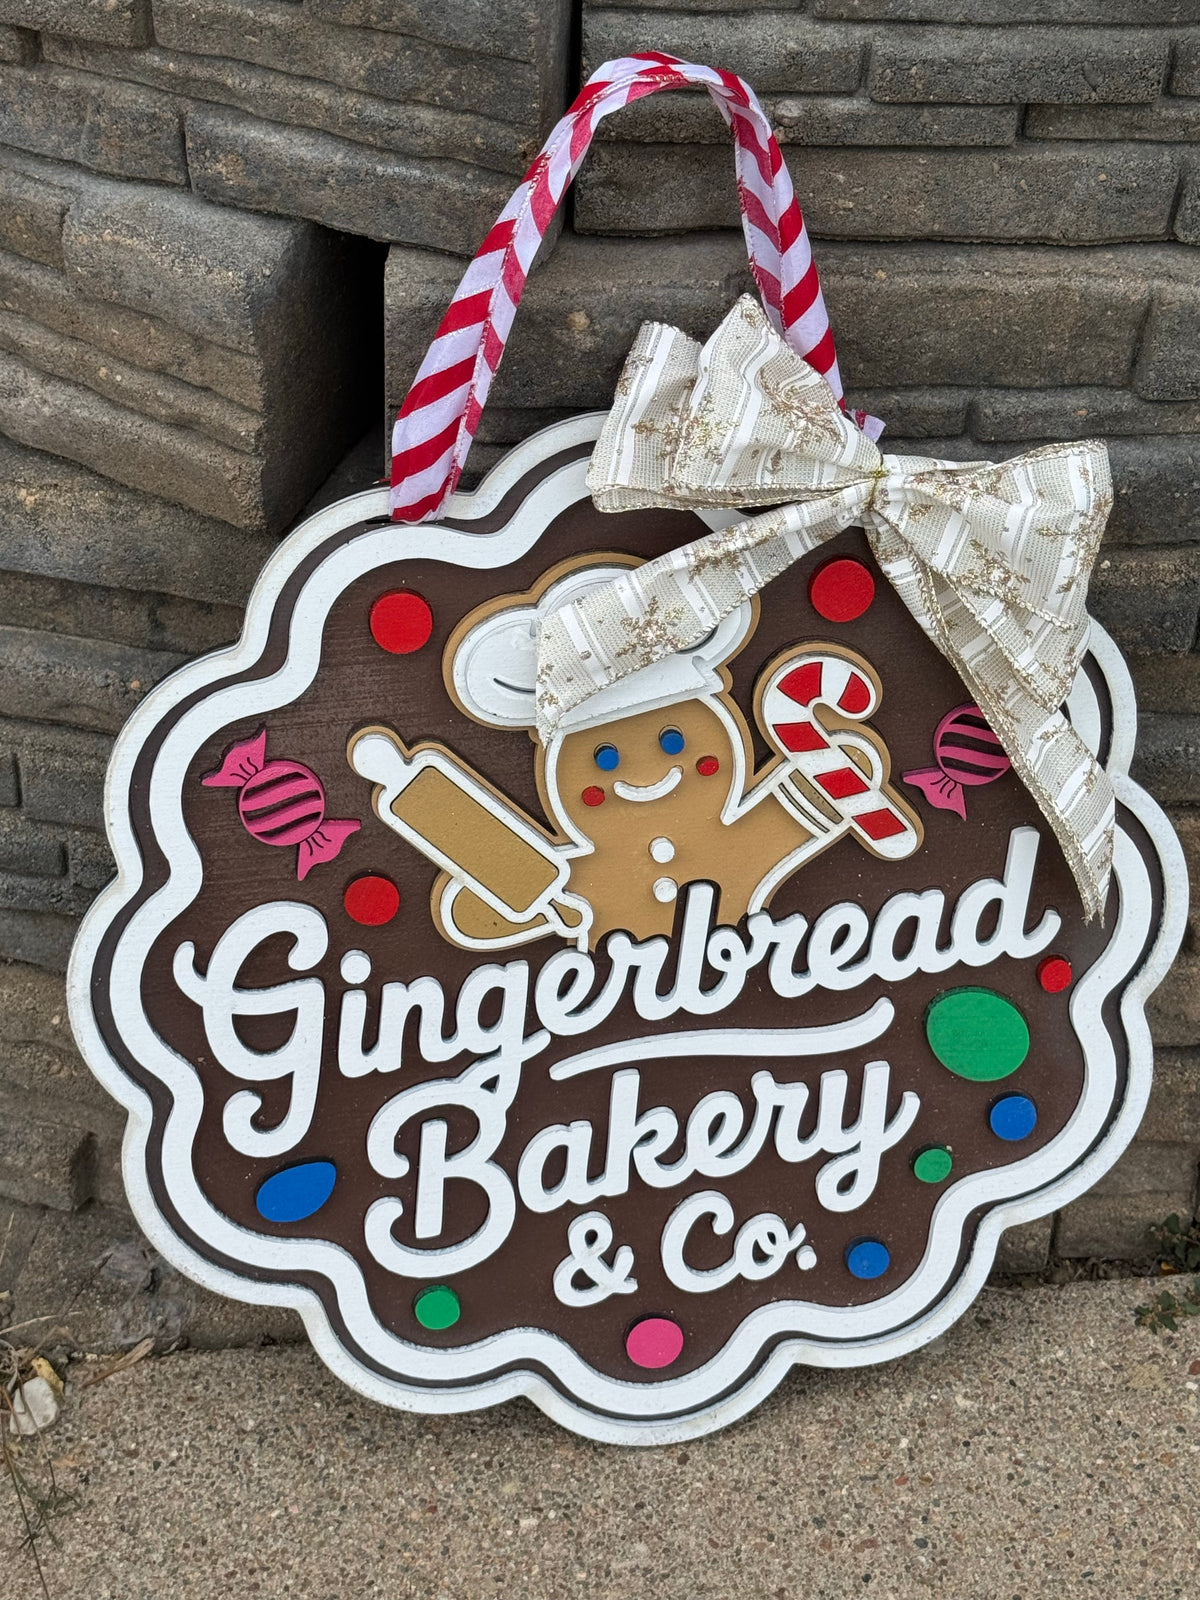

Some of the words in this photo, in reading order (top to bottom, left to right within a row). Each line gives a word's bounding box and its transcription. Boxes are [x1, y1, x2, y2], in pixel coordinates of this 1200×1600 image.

[173, 827, 1061, 1157] Gingerbread
[364, 1061, 920, 1278] Bakery
[553, 1211, 638, 1307] &
[661, 1190, 817, 1293] Co.
